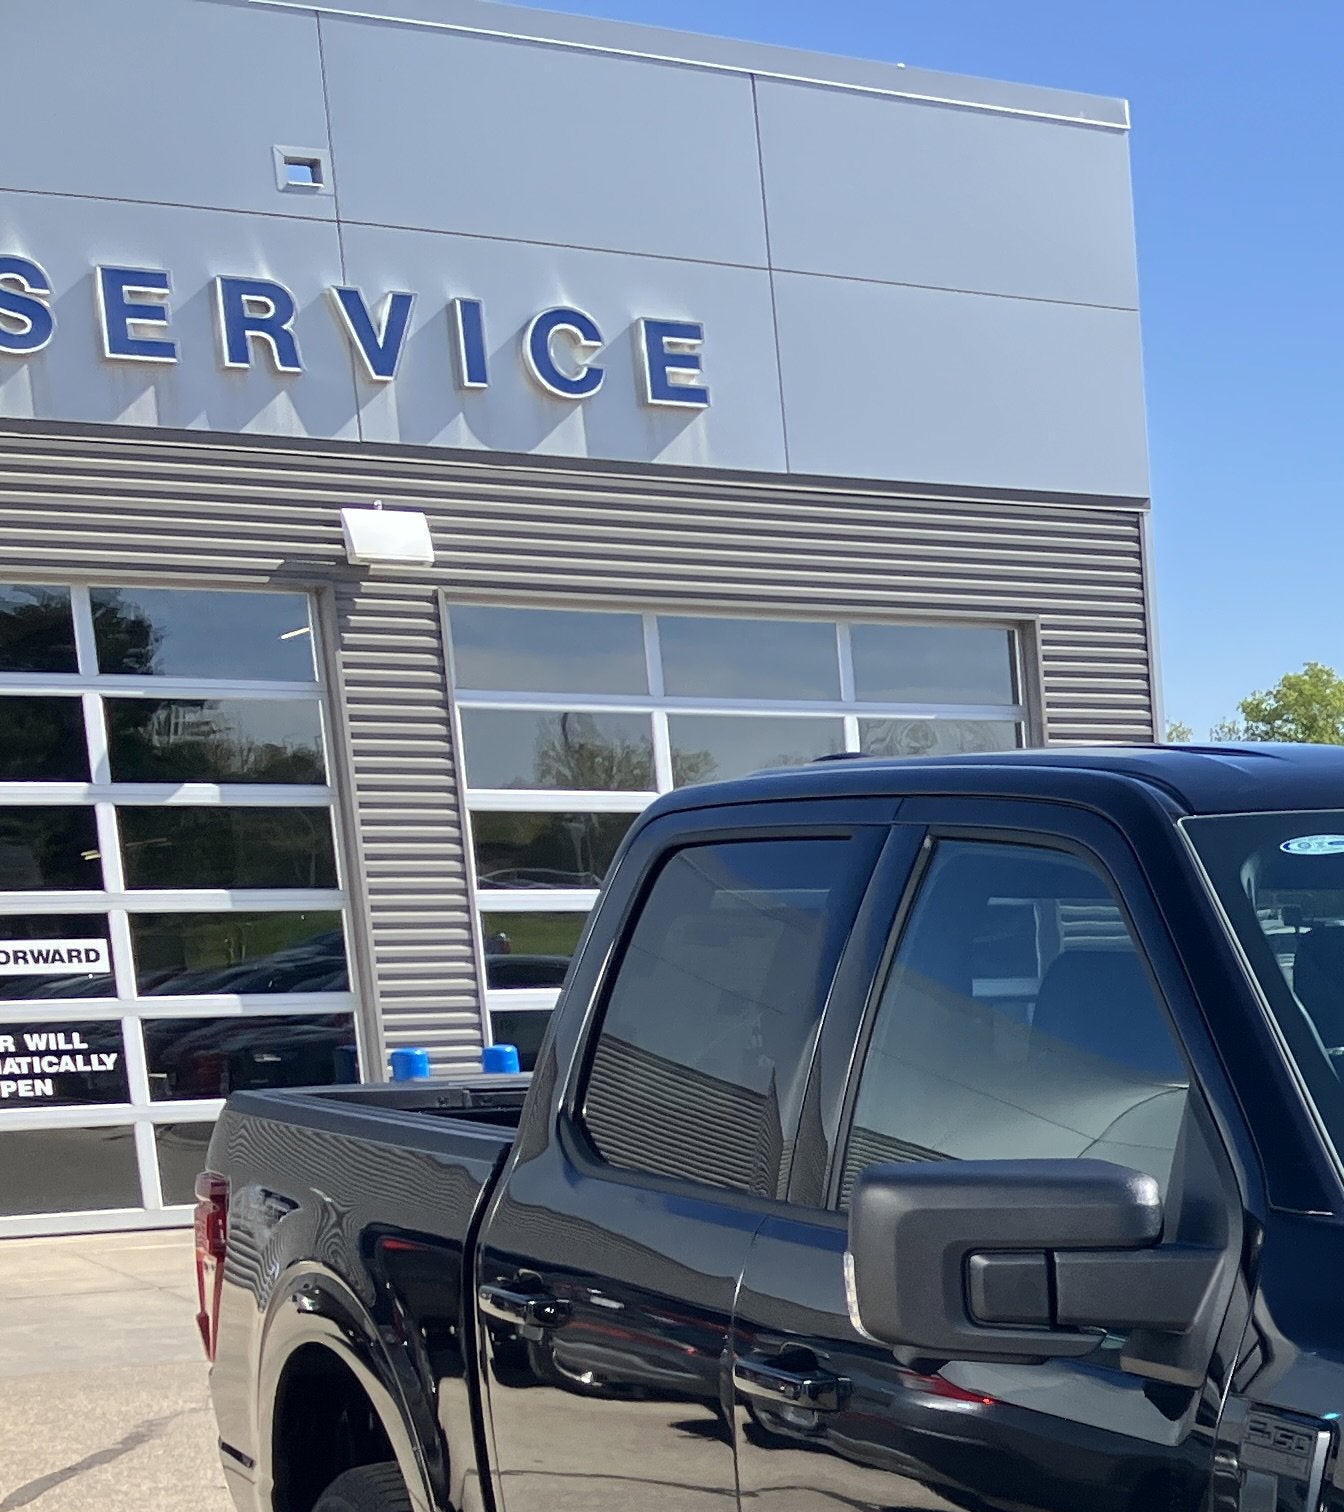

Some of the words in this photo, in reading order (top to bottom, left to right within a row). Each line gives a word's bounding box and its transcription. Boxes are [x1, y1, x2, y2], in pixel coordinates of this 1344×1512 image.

[0, 252, 712, 409] SERVICE
[23, 1032, 89, 1051] WILL
[0, 1053, 118, 1076] ATICALLY
